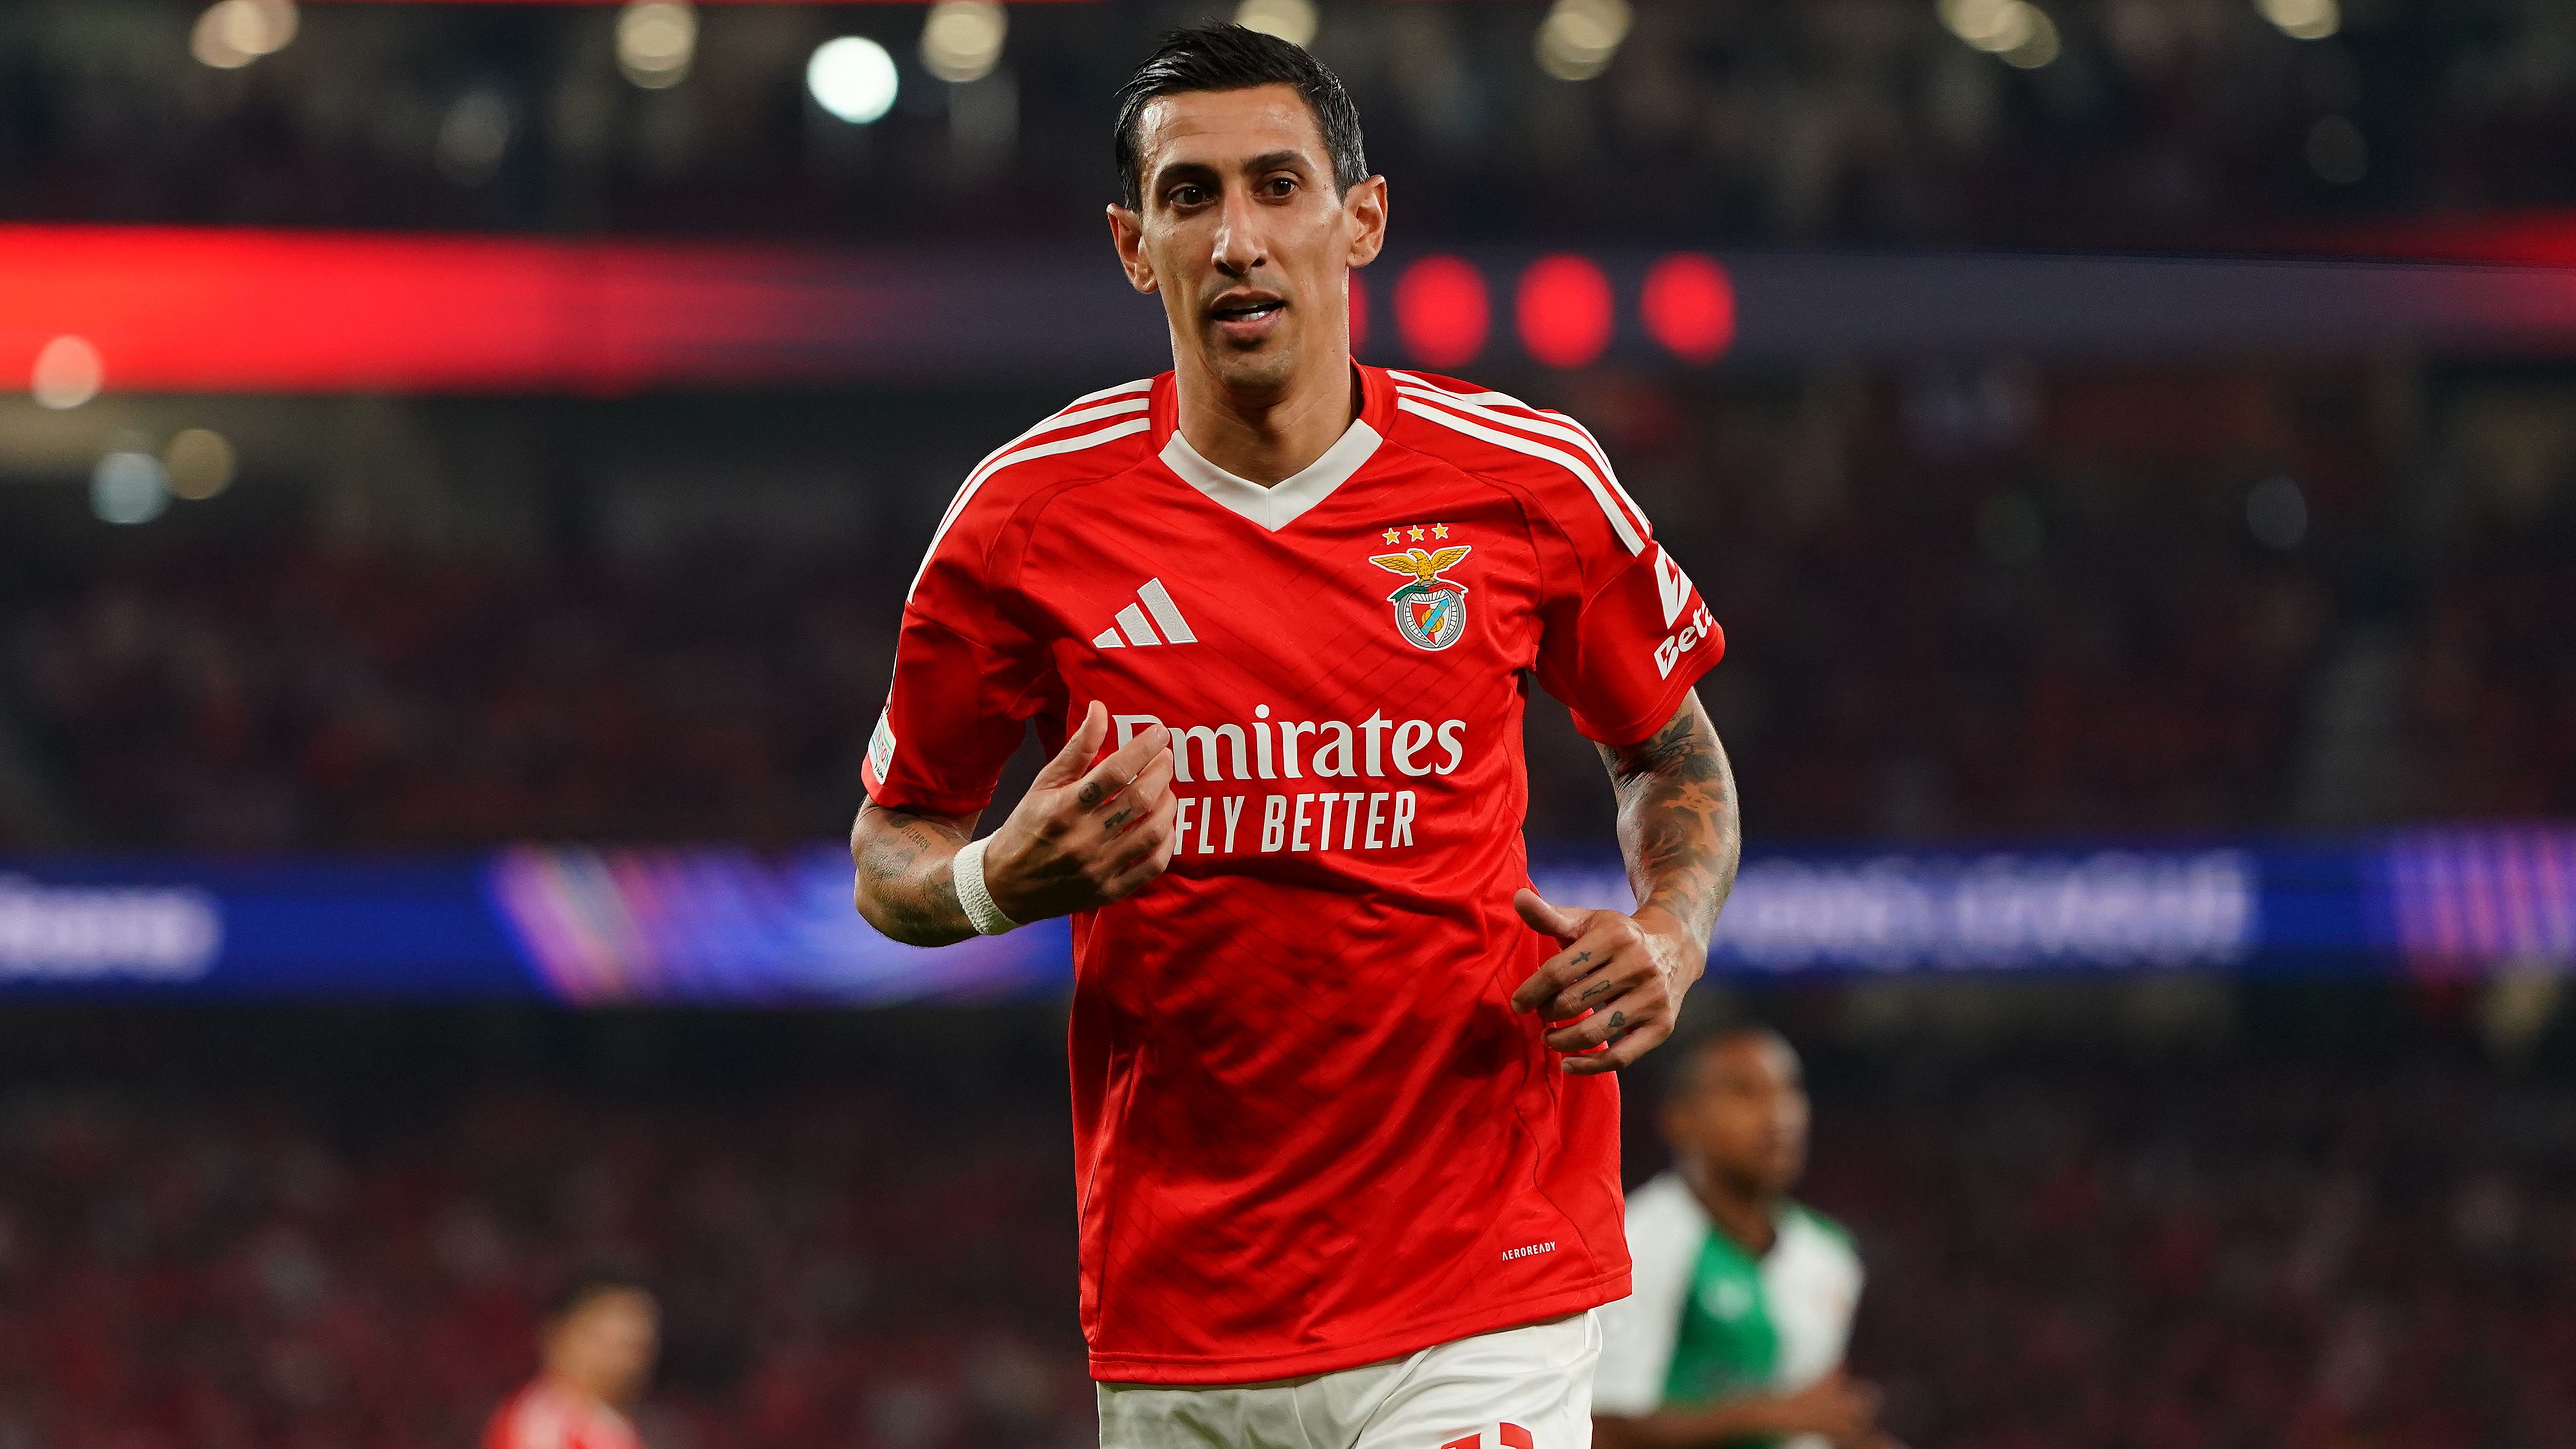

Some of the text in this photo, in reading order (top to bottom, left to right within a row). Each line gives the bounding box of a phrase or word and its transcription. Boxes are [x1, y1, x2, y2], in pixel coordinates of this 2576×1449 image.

[1173, 790, 1417, 855] FLY BETTER
[1502, 1241, 1556, 1261] AEROREADY
